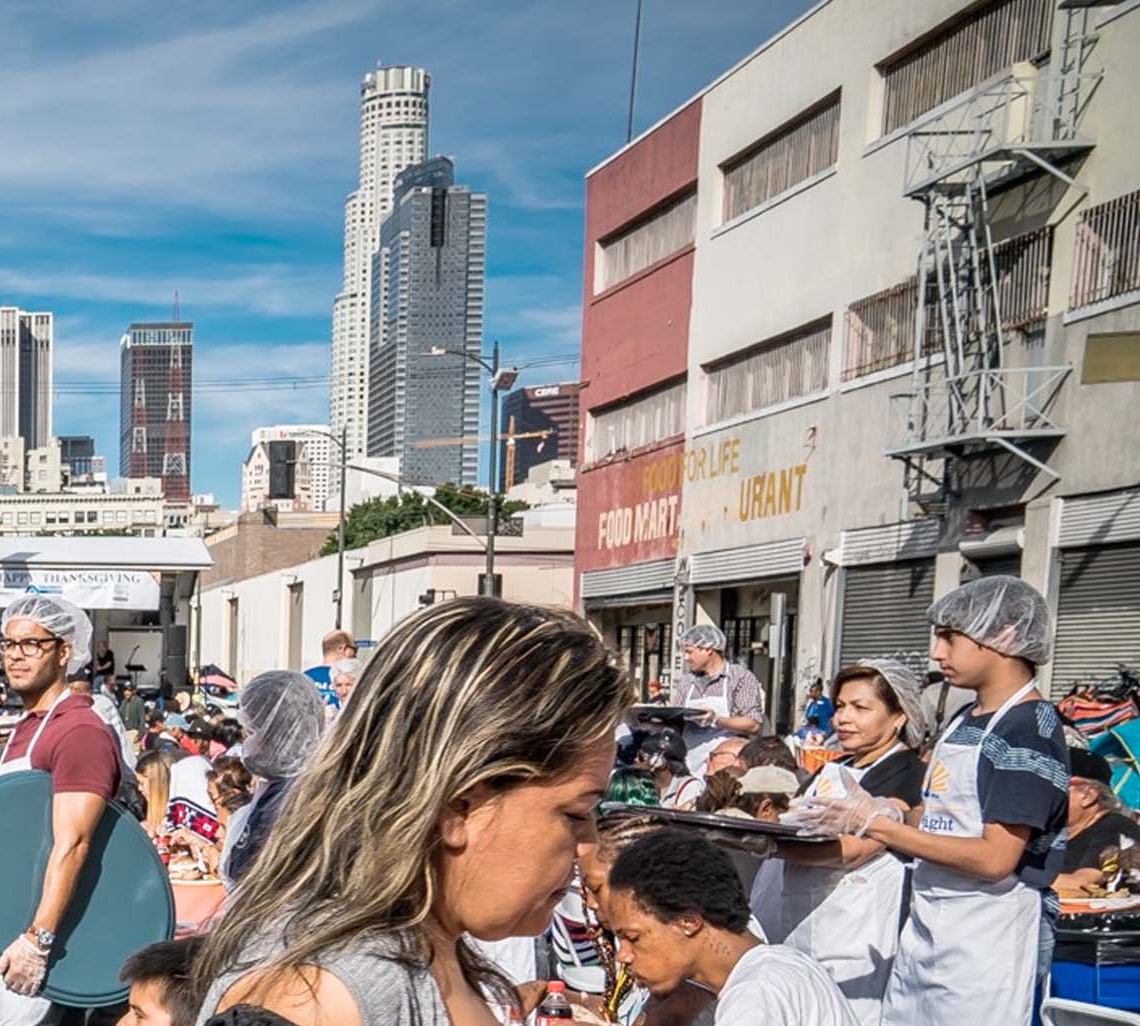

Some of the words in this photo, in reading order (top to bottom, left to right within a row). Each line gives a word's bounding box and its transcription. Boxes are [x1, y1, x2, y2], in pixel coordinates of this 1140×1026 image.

[710, 438, 741, 478] LIFE
[598, 507, 631, 550] FOOD
[634, 495, 678, 543] MART
[44, 572, 140, 583] THANKSGIVING
